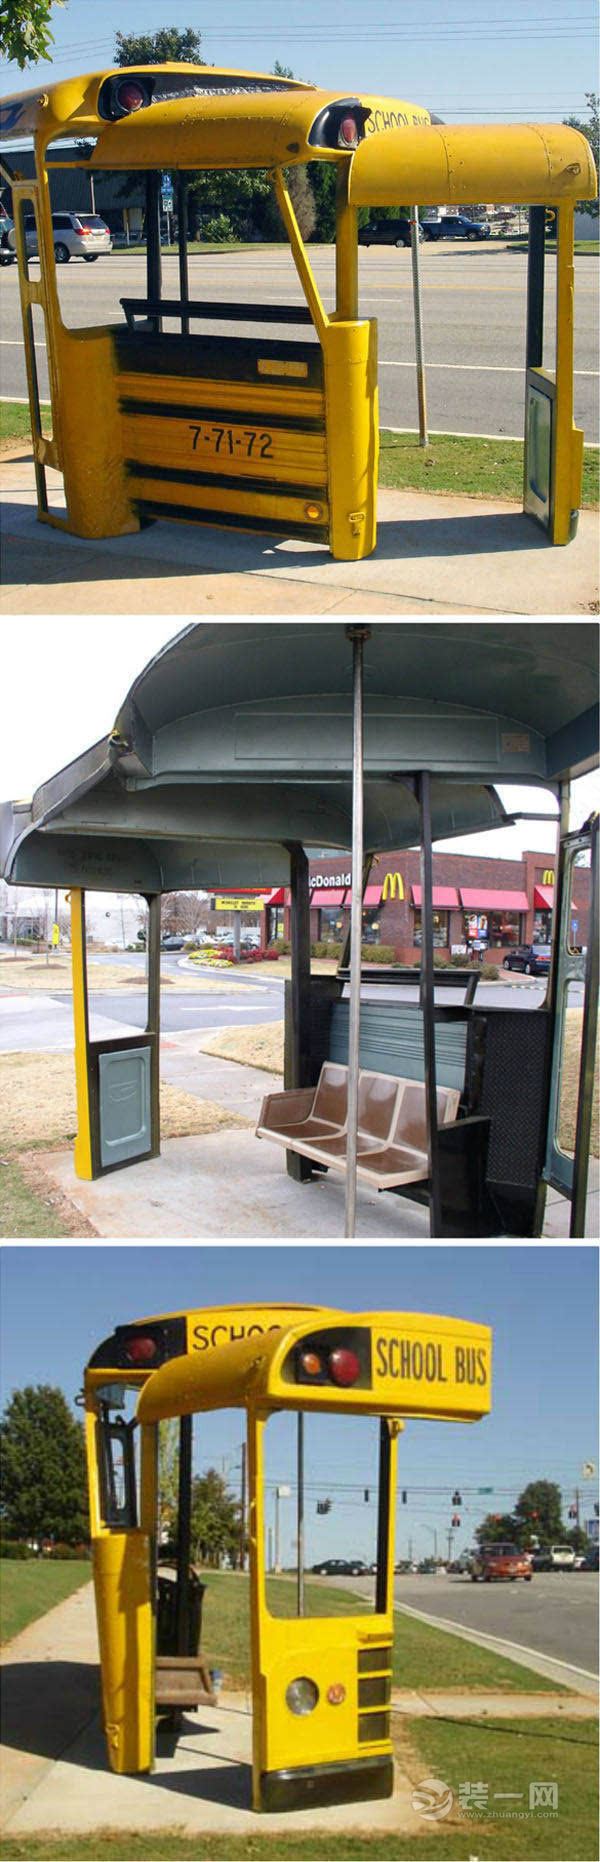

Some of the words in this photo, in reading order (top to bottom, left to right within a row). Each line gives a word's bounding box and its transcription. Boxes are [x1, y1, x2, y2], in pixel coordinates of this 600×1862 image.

[189, 425, 273, 458] 7-71-72
[309, 873, 351, 887] cDonald
[193, 1325, 281, 1350] SCH
[376, 1336, 448, 1382] SCHOOL
[455, 1346, 487, 1386] BUS
